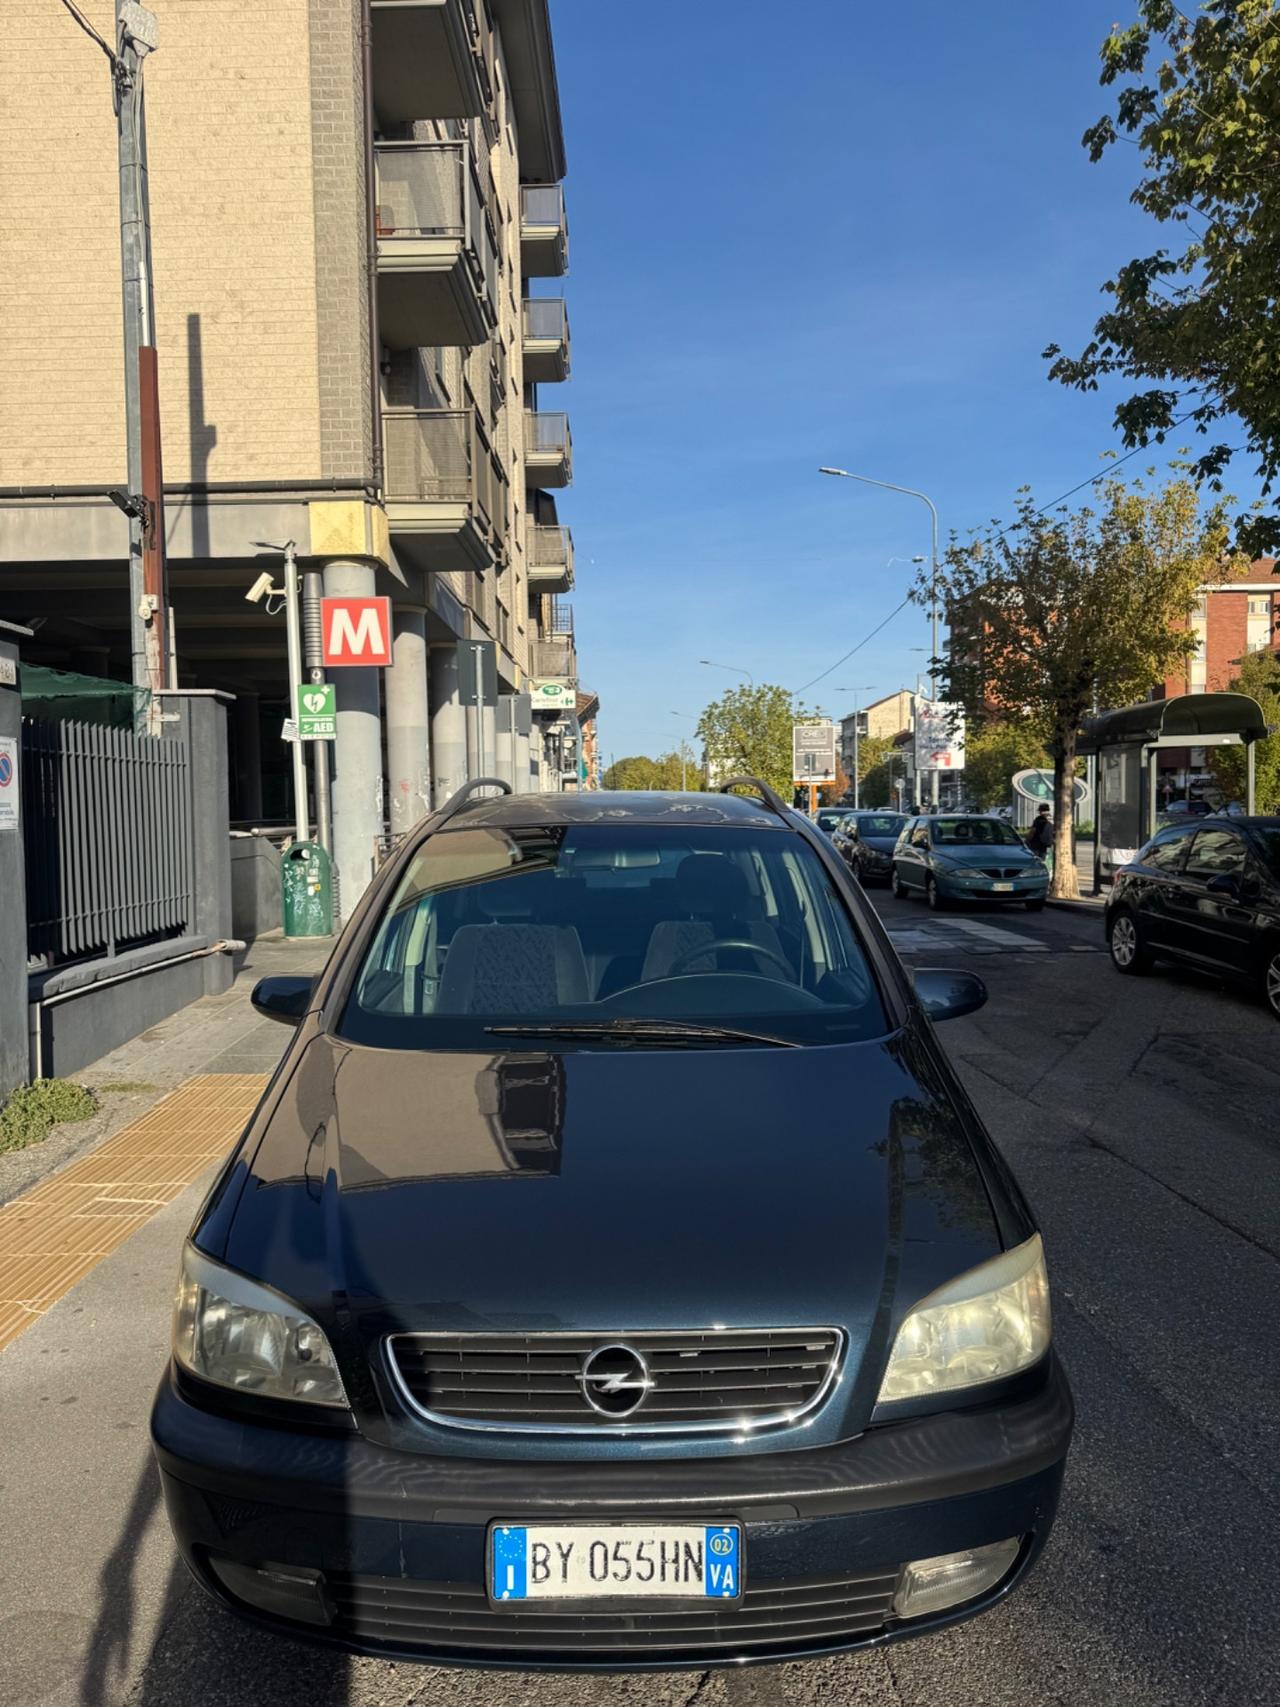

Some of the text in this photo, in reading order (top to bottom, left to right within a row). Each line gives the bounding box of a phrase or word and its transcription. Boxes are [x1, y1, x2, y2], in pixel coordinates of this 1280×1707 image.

[328, 608, 385, 655] M
[313, 722, 334, 733] AED
[713, 1538, 728, 1552] 02
[710, 1563, 735, 1590] VA
